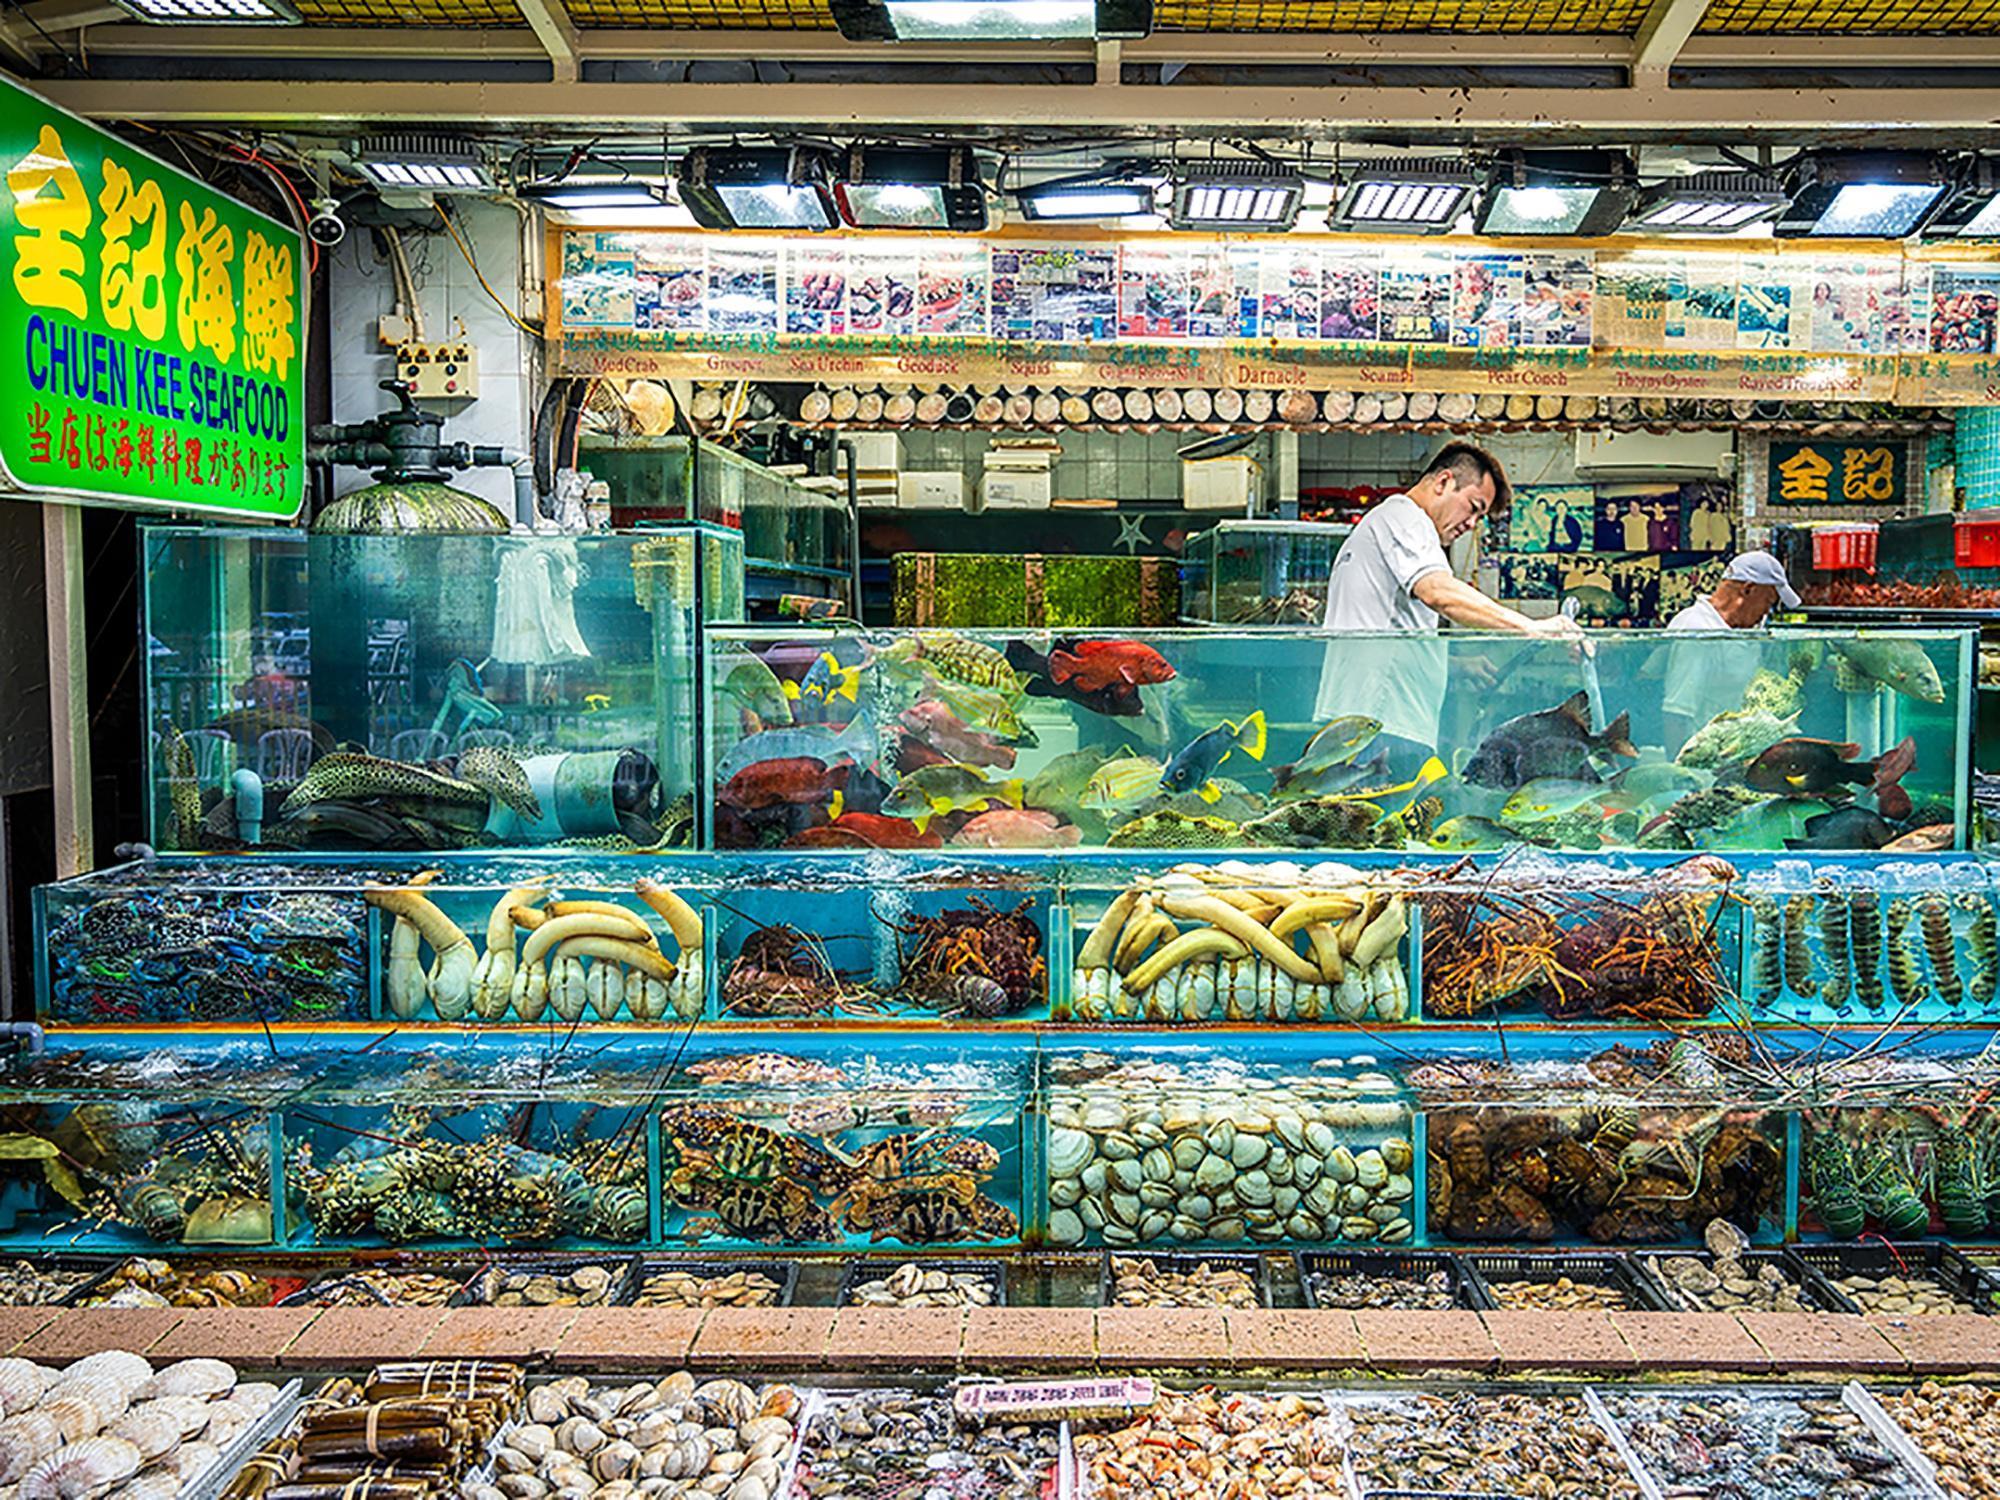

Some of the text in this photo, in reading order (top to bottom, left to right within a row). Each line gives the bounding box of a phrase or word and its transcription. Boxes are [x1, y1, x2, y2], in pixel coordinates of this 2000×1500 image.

[7, 125, 294, 381] 全記海鮮
[26, 314, 288, 442] CHUEN KEE SEAFOOD
[1011, 361, 1050, 377] Squid
[27, 402, 289, 501] 当店は海鮮料理があります
[1778, 446, 1894, 501] 全記
